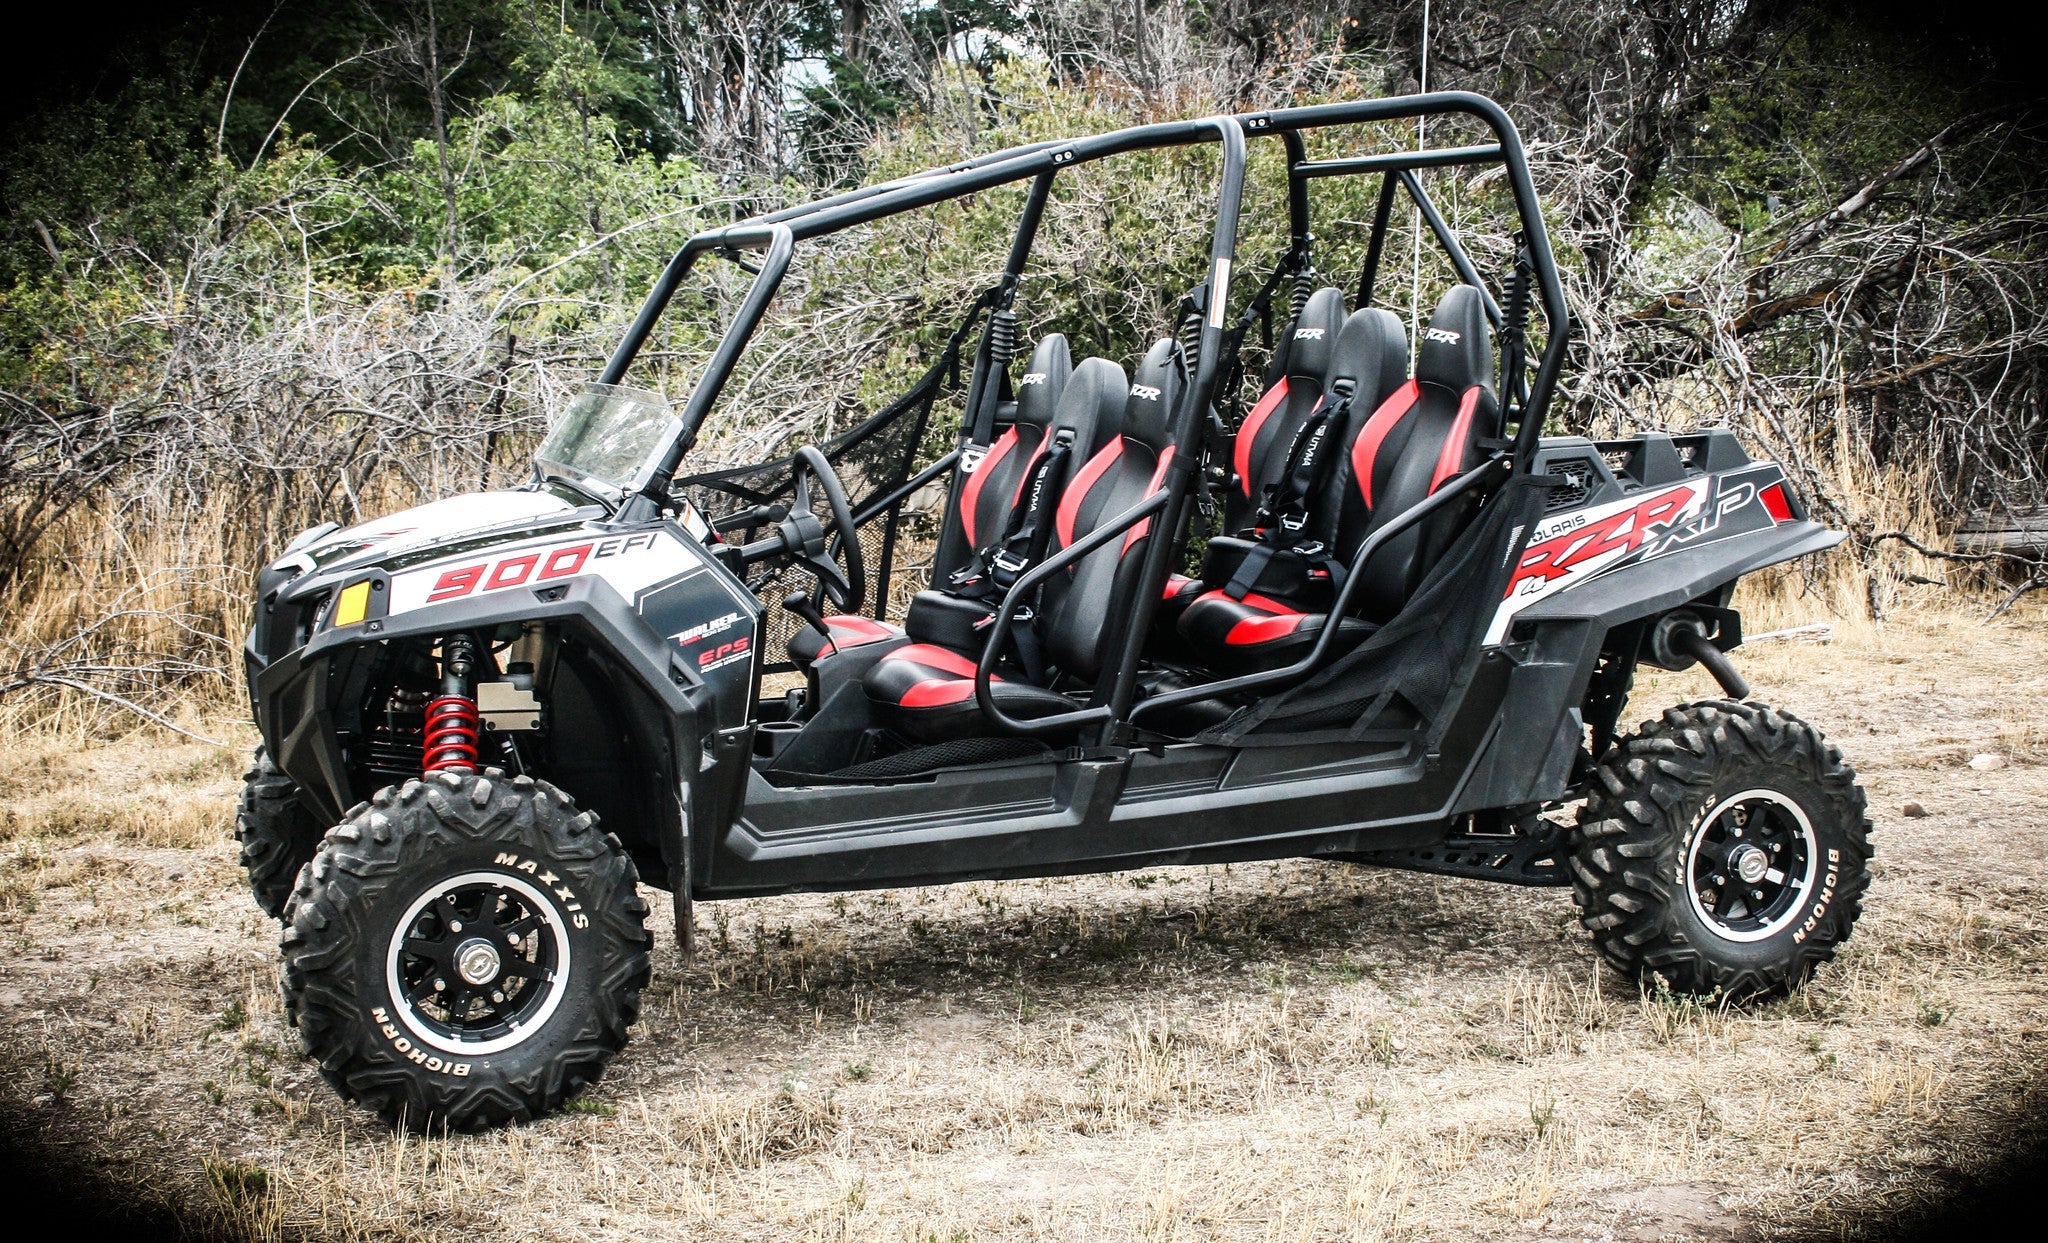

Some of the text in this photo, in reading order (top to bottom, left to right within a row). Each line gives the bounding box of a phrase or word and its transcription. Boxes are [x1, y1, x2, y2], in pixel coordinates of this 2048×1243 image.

[1293, 328, 1325, 341] RZR
[1425, 328, 1461, 345] RZR
[1020, 373, 1047, 386] RZR
[1130, 383, 1161, 401] RZR
[1532, 514, 1586, 543] OLARIS
[1639, 482, 1755, 561] XP
[1503, 485, 1696, 600] RZR
[426, 533, 658, 603] 900 EFI
[1521, 574, 1547, 596] 4
[673, 612, 742, 642] WALKER
[698, 637, 750, 665] EPS
[495, 853, 589, 930] MAXXIS
[1793, 848, 1840, 945] BIGHORN
[371, 1006, 473, 1077] BIGHORN
